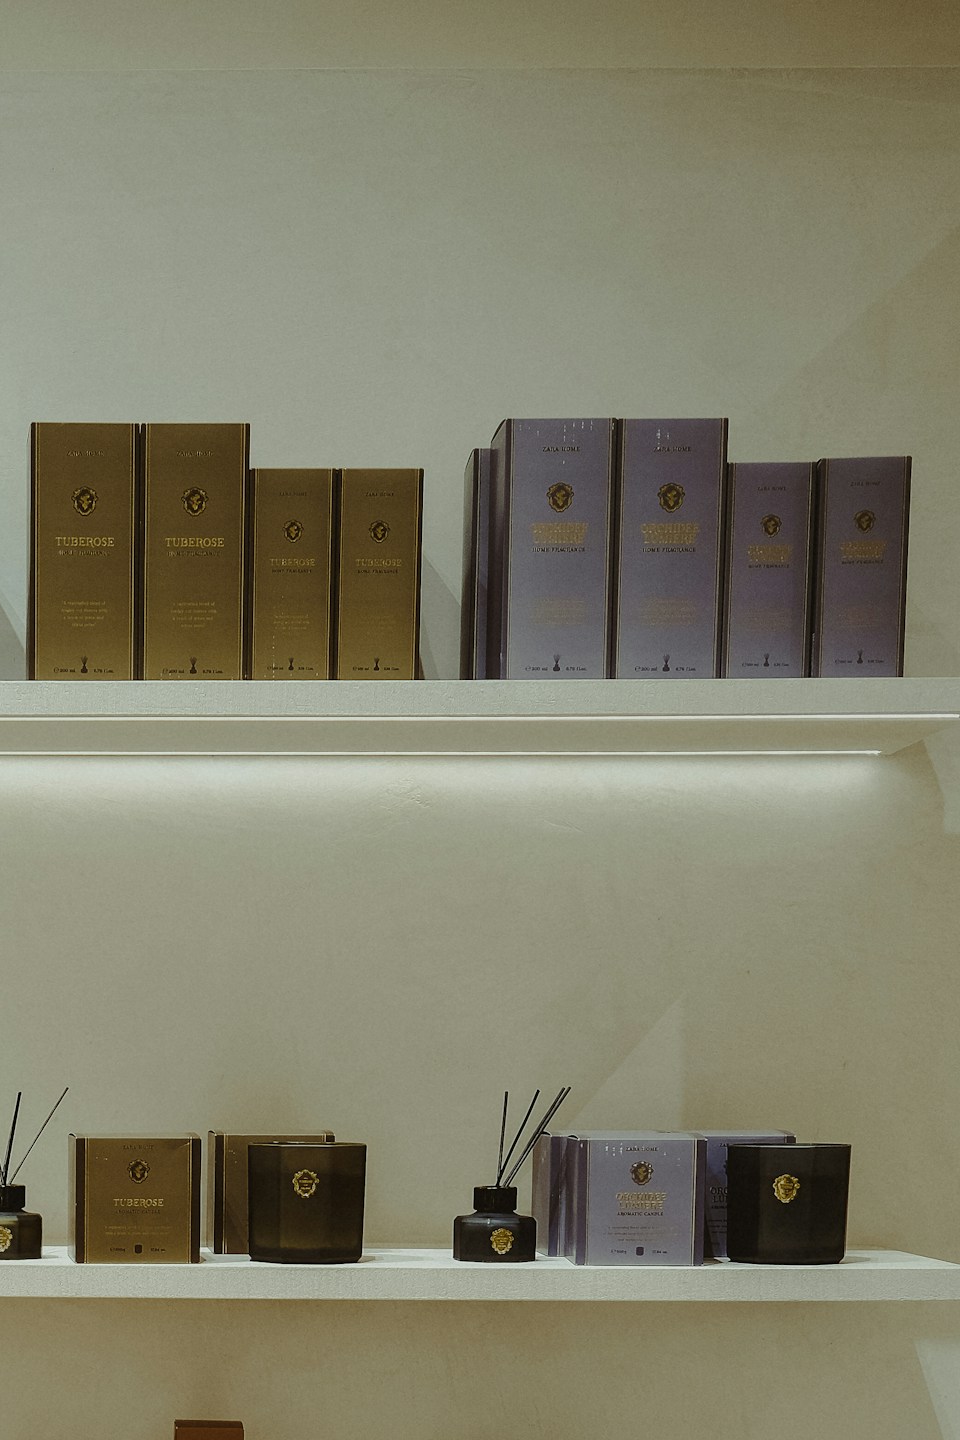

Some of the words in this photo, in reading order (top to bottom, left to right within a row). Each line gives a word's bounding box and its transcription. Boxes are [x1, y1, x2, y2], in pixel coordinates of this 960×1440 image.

[55, 536, 115, 548] TUBEROSE
[164, 537, 225, 549] TUBEROSE
[269, 558, 316, 567] TUBEROSE
[355, 559, 402, 567] TUBEROSE
[113, 1198, 165, 1208] TUBEROSE
